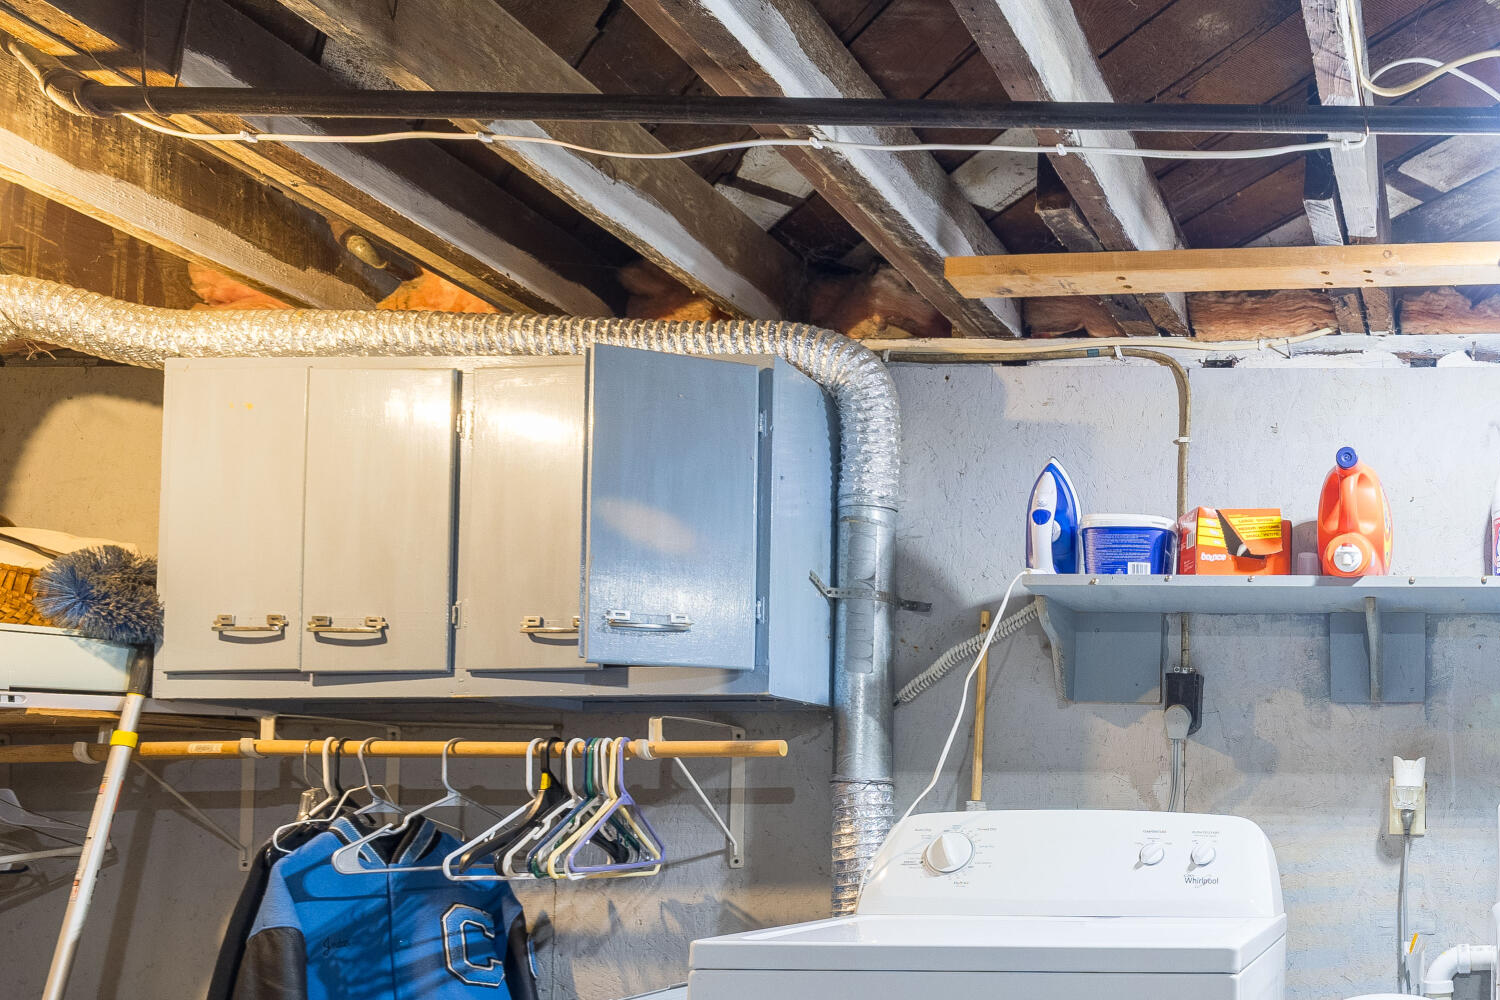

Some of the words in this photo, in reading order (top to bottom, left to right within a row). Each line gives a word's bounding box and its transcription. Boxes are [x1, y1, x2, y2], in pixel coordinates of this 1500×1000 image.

[1200, 552, 1227, 562] bounce
[1184, 877, 1219, 886] Whirlpool
[440, 903, 507, 988] C
